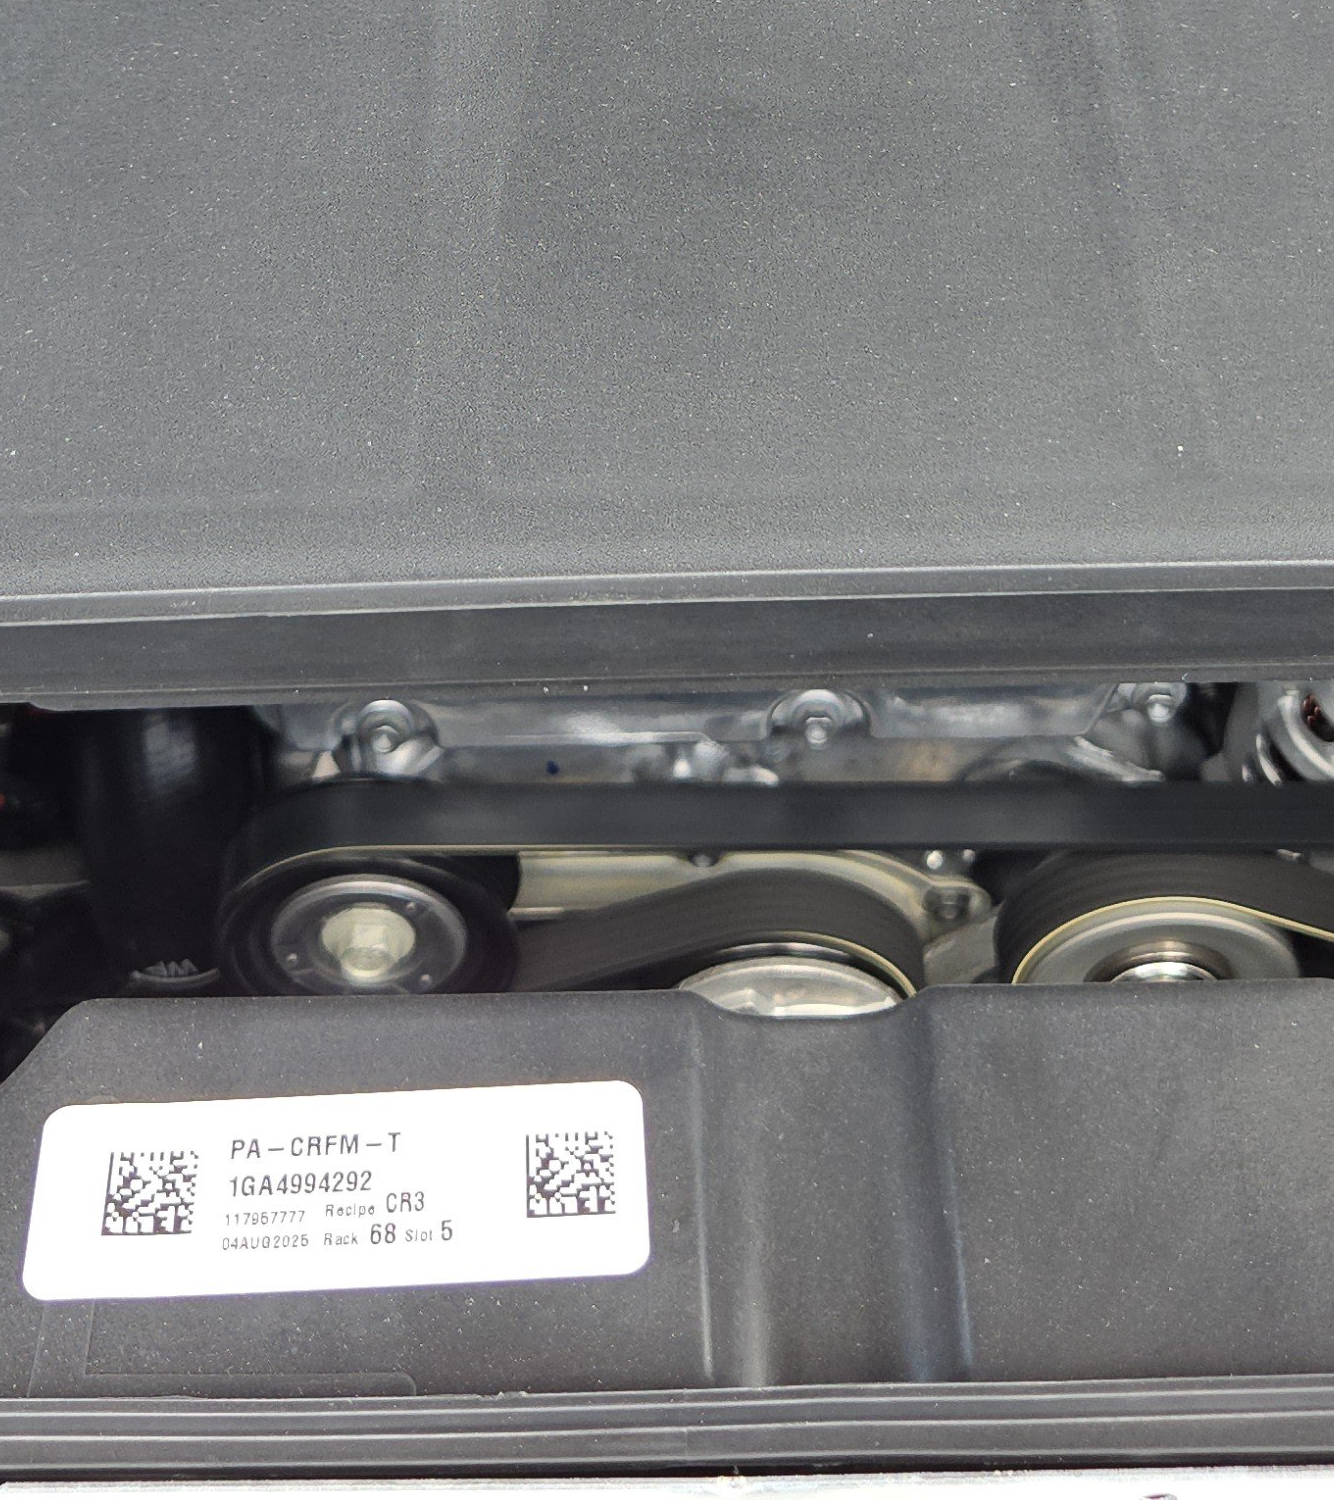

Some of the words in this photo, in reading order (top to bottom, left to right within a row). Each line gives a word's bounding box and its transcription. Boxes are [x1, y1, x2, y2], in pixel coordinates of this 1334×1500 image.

[228, 1170, 372, 1198] 1GA4994292
[325, 1203, 375, 1218] Recipe
[385, 1190, 425, 1214] CR3
[323, 1232, 358, 1246] Rack
[369, 1222, 397, 1245] 68
[404, 1230, 433, 1242] Slot
[440, 1219, 453, 1241] 5
